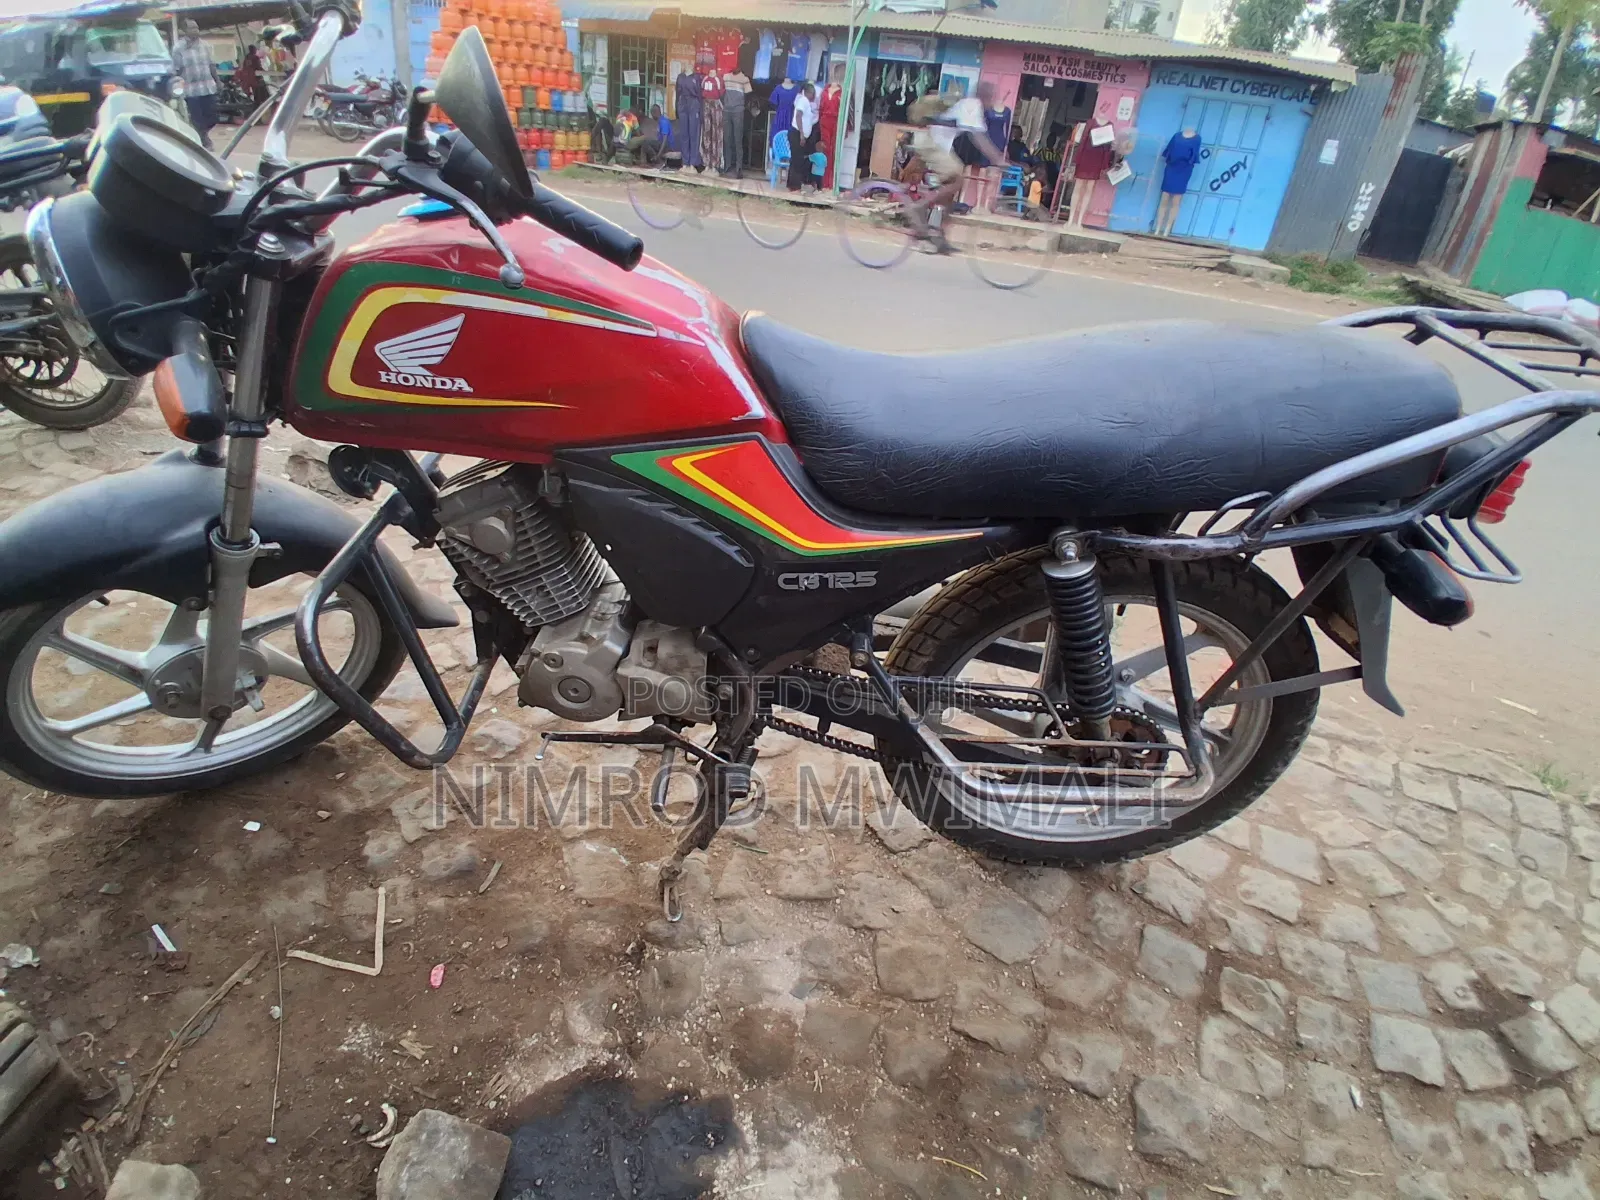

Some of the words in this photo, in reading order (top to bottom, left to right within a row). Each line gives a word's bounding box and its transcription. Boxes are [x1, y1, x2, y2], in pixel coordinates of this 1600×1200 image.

[1022, 52, 1051, 63] MAMA
[1084, 60, 1122, 72] BEAUTY
[1023, 62, 1056, 75] SALON
[1065, 68, 1127, 84] COSMESTICS
[1230, 79, 1280, 99] CYBER
[1209, 155, 1248, 192] COPY
[378, 371, 474, 393] HONDA
